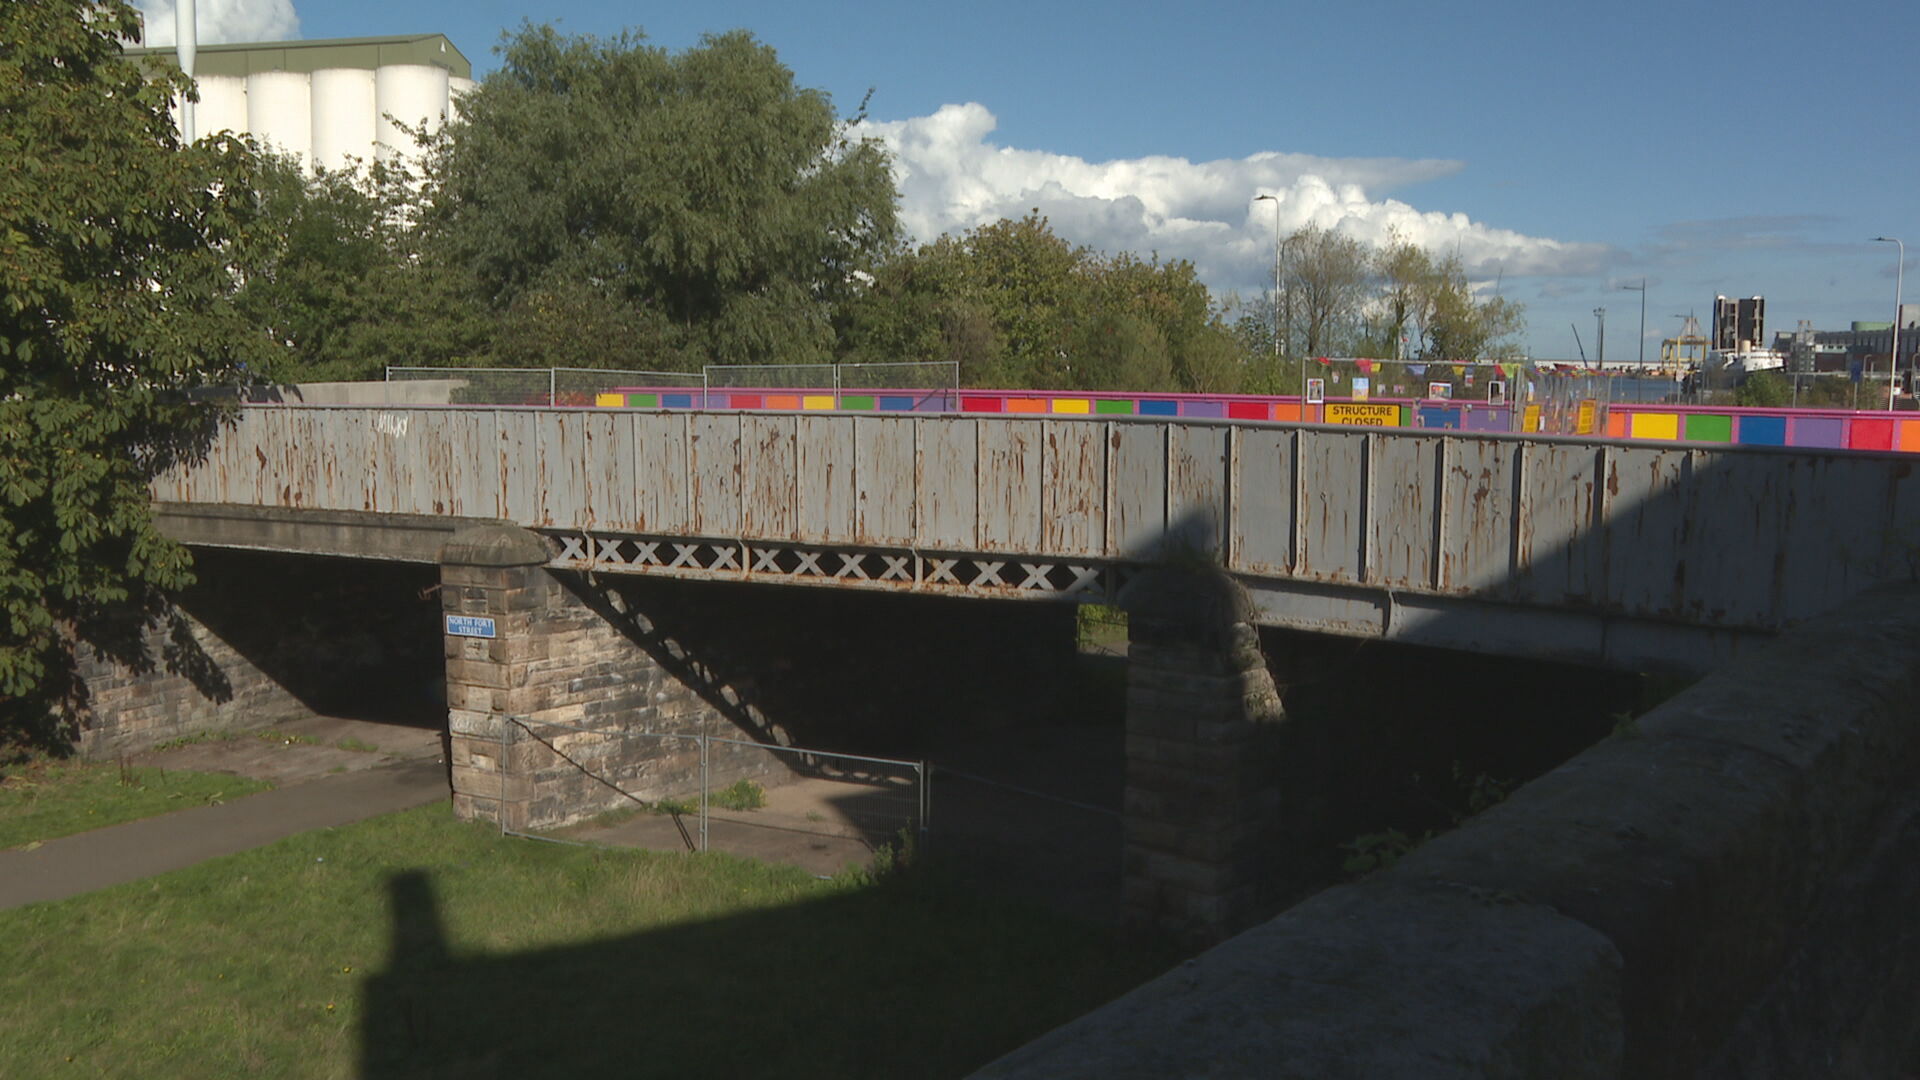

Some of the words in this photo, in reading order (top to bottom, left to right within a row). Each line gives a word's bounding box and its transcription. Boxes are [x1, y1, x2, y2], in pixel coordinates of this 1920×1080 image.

[1333, 405, 1393, 416] STRUCTURE
[1341, 417, 1383, 427] CLOSED
[448, 616, 471, 626] NORTH
[458, 626, 483, 635] STREET
